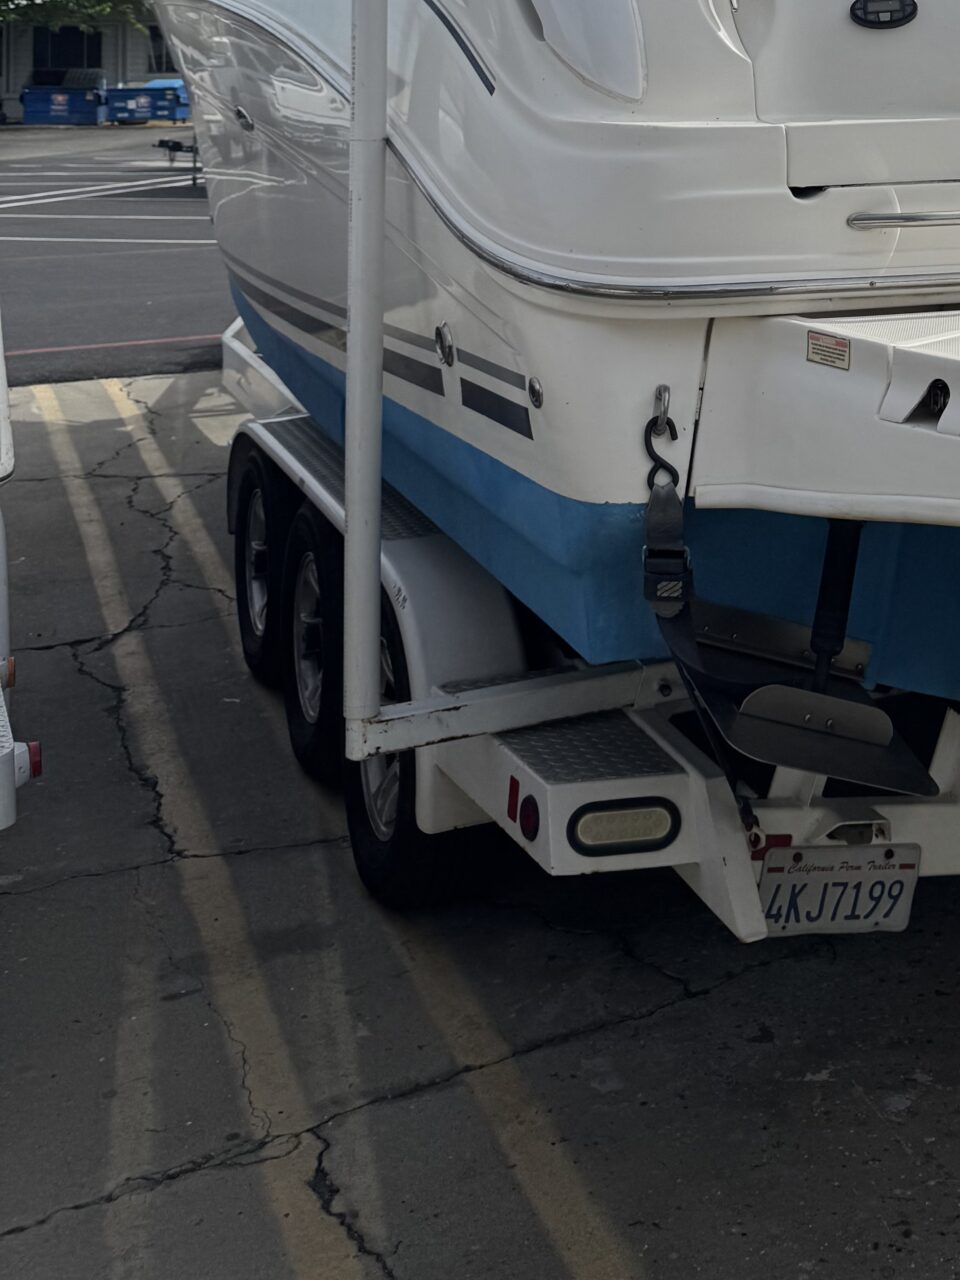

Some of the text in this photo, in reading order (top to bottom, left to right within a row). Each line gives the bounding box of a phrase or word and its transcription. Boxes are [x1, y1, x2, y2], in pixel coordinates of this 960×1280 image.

[787, 860, 897, 875] California Perm Trailer
[765, 880, 904, 924] 4KJ7199
